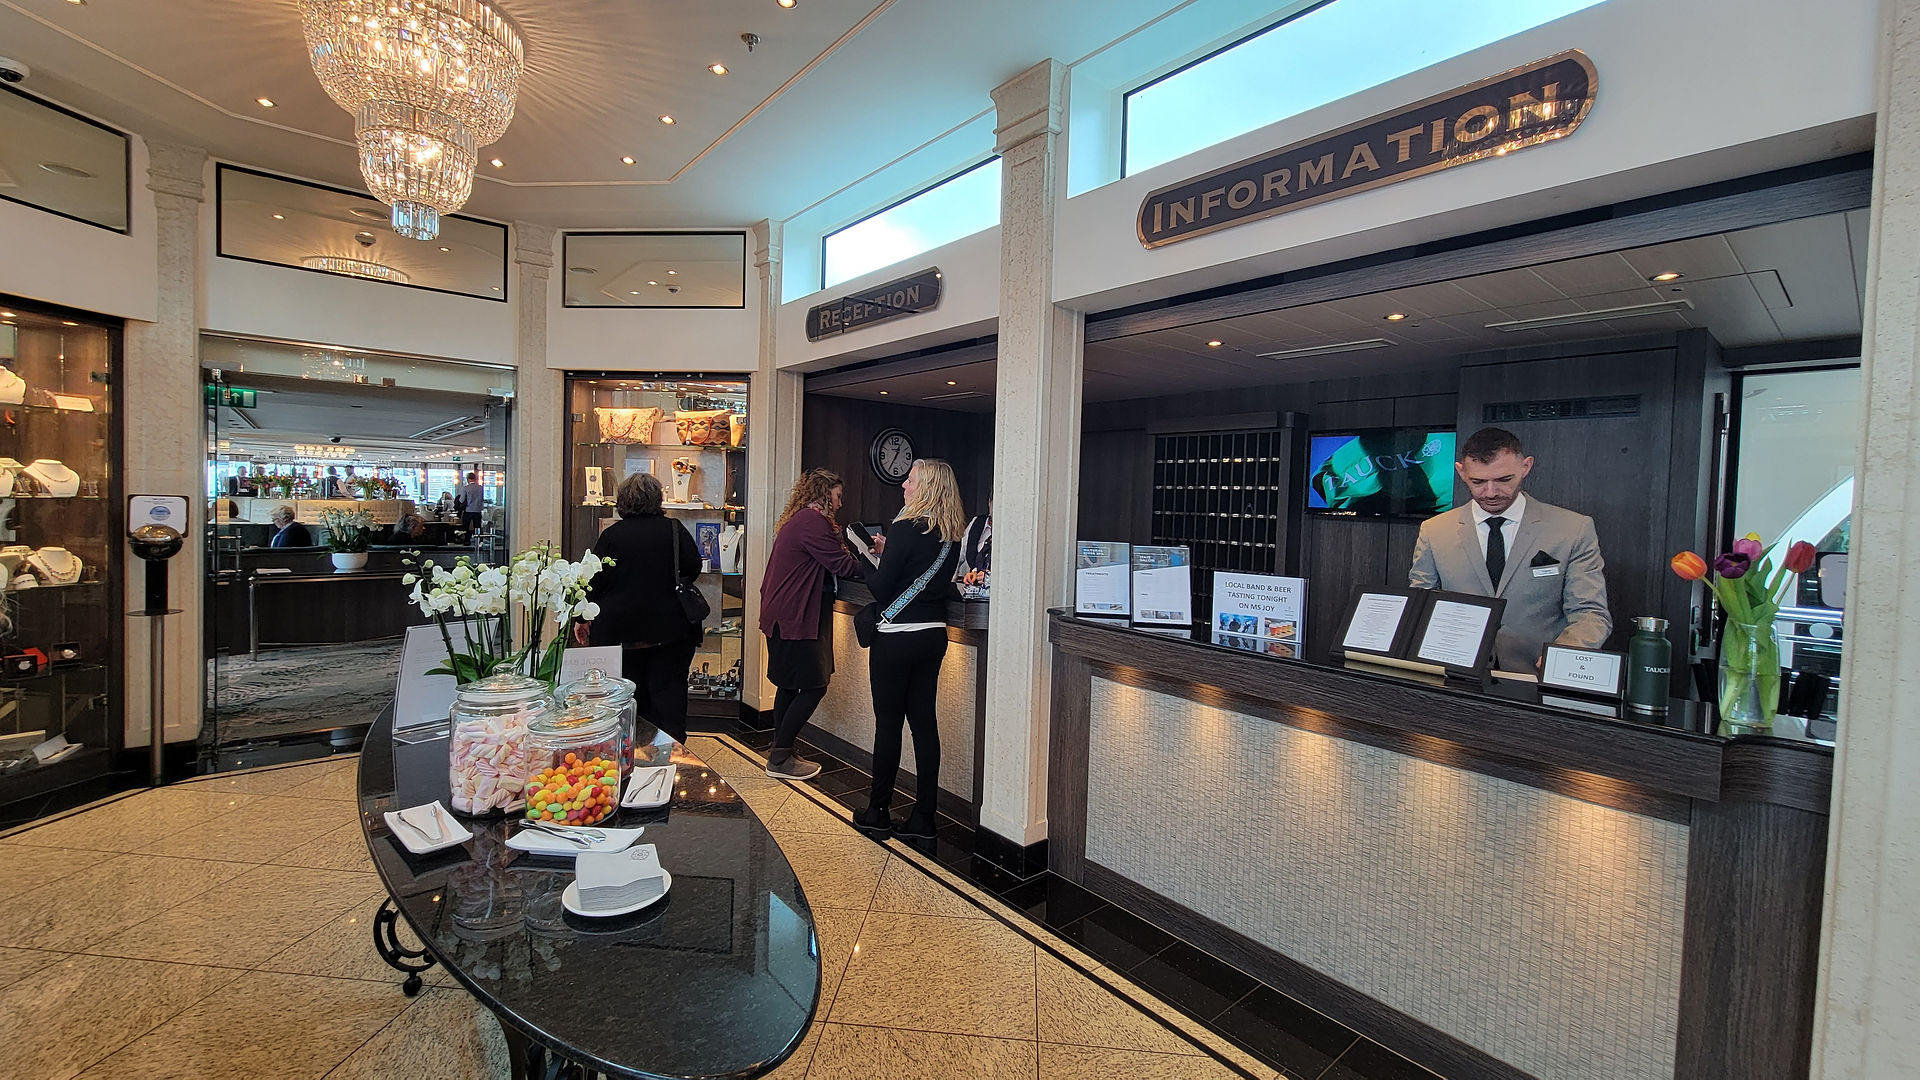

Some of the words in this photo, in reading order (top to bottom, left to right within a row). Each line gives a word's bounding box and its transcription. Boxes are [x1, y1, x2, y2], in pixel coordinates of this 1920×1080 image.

[1152, 81, 1562, 234] INFORMATION
[820, 284, 920, 330] RECEPTION
[891, 437, 900, 445] 12
[906, 452, 912, 460] 3
[893, 467, 899, 475] 6
[1325, 450, 1425, 491] TAUCK
[1225, 581, 1245, 589] LOCAL
[1246, 583, 1266, 591] BAND
[1228, 592, 1256, 600] TASTING
[1257, 594, 1288, 603] TONIGHT
[1568, 672, 1595, 681] FOUND
